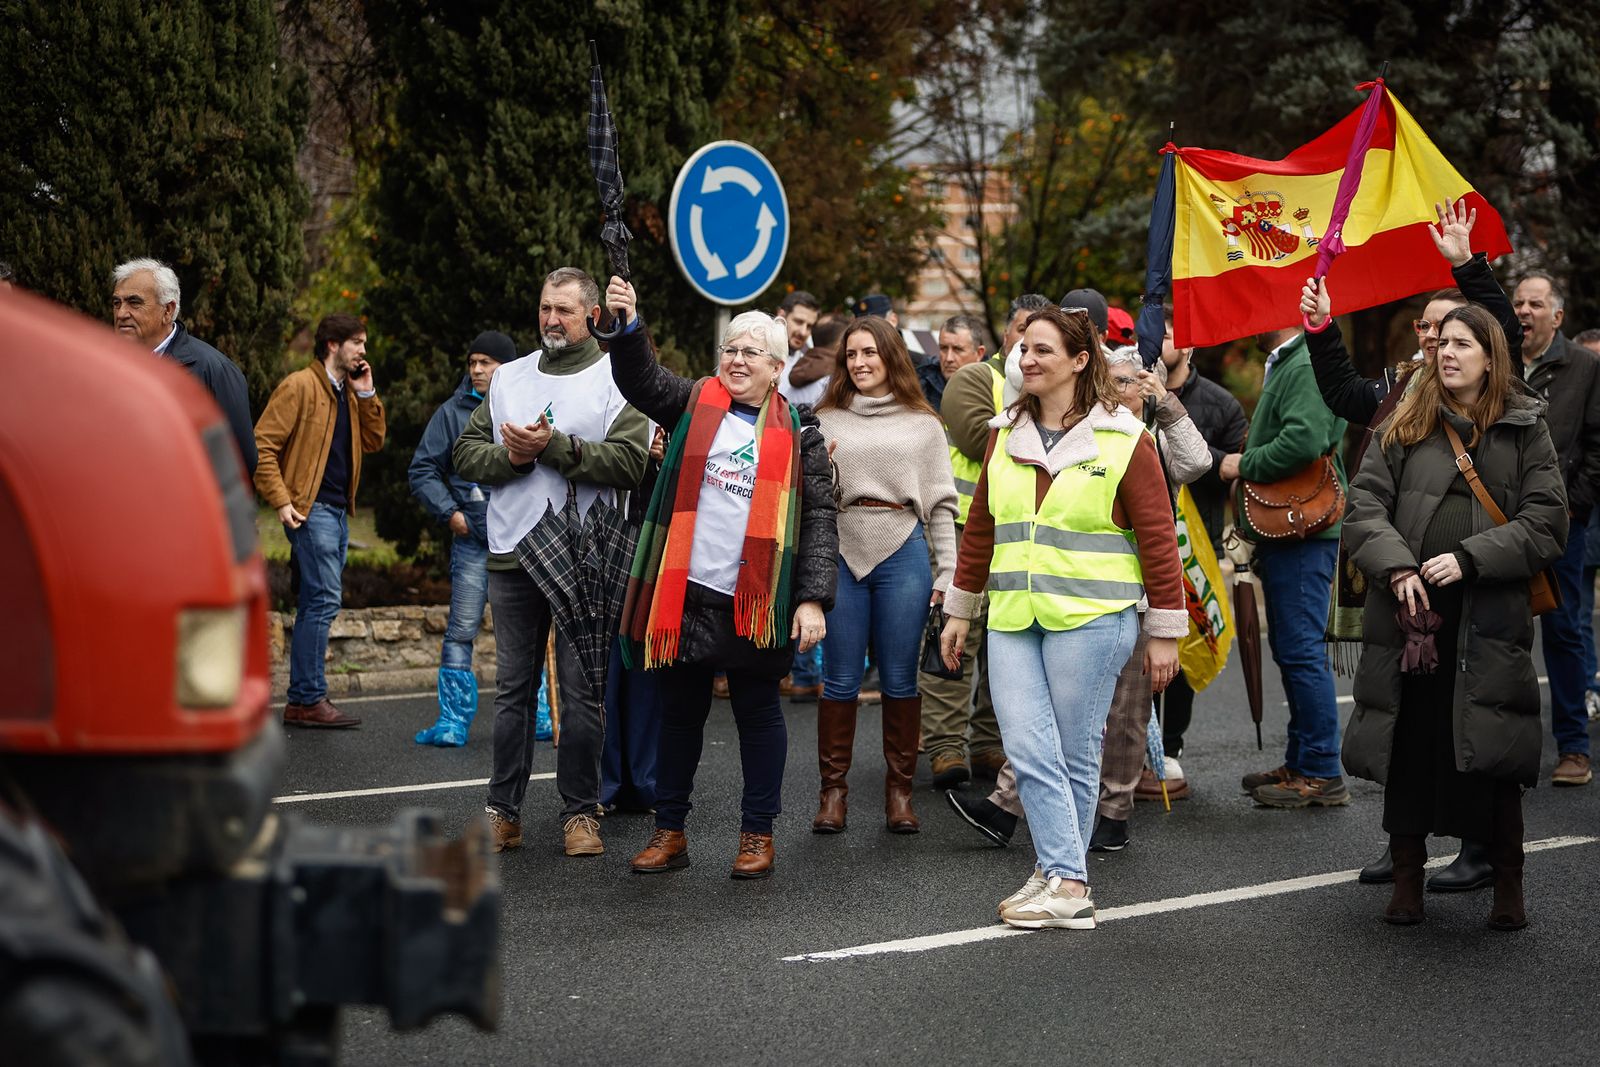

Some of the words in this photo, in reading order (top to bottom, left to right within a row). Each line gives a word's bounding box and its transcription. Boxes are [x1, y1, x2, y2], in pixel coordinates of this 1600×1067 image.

[705, 460, 717, 472] NO
[714, 466, 721, 474] A
[720, 469, 740, 482] ESTA
[706, 475, 723, 489] ESTE
[724, 482, 753, 499] MERCO
[1176, 519, 1225, 637] OAG
